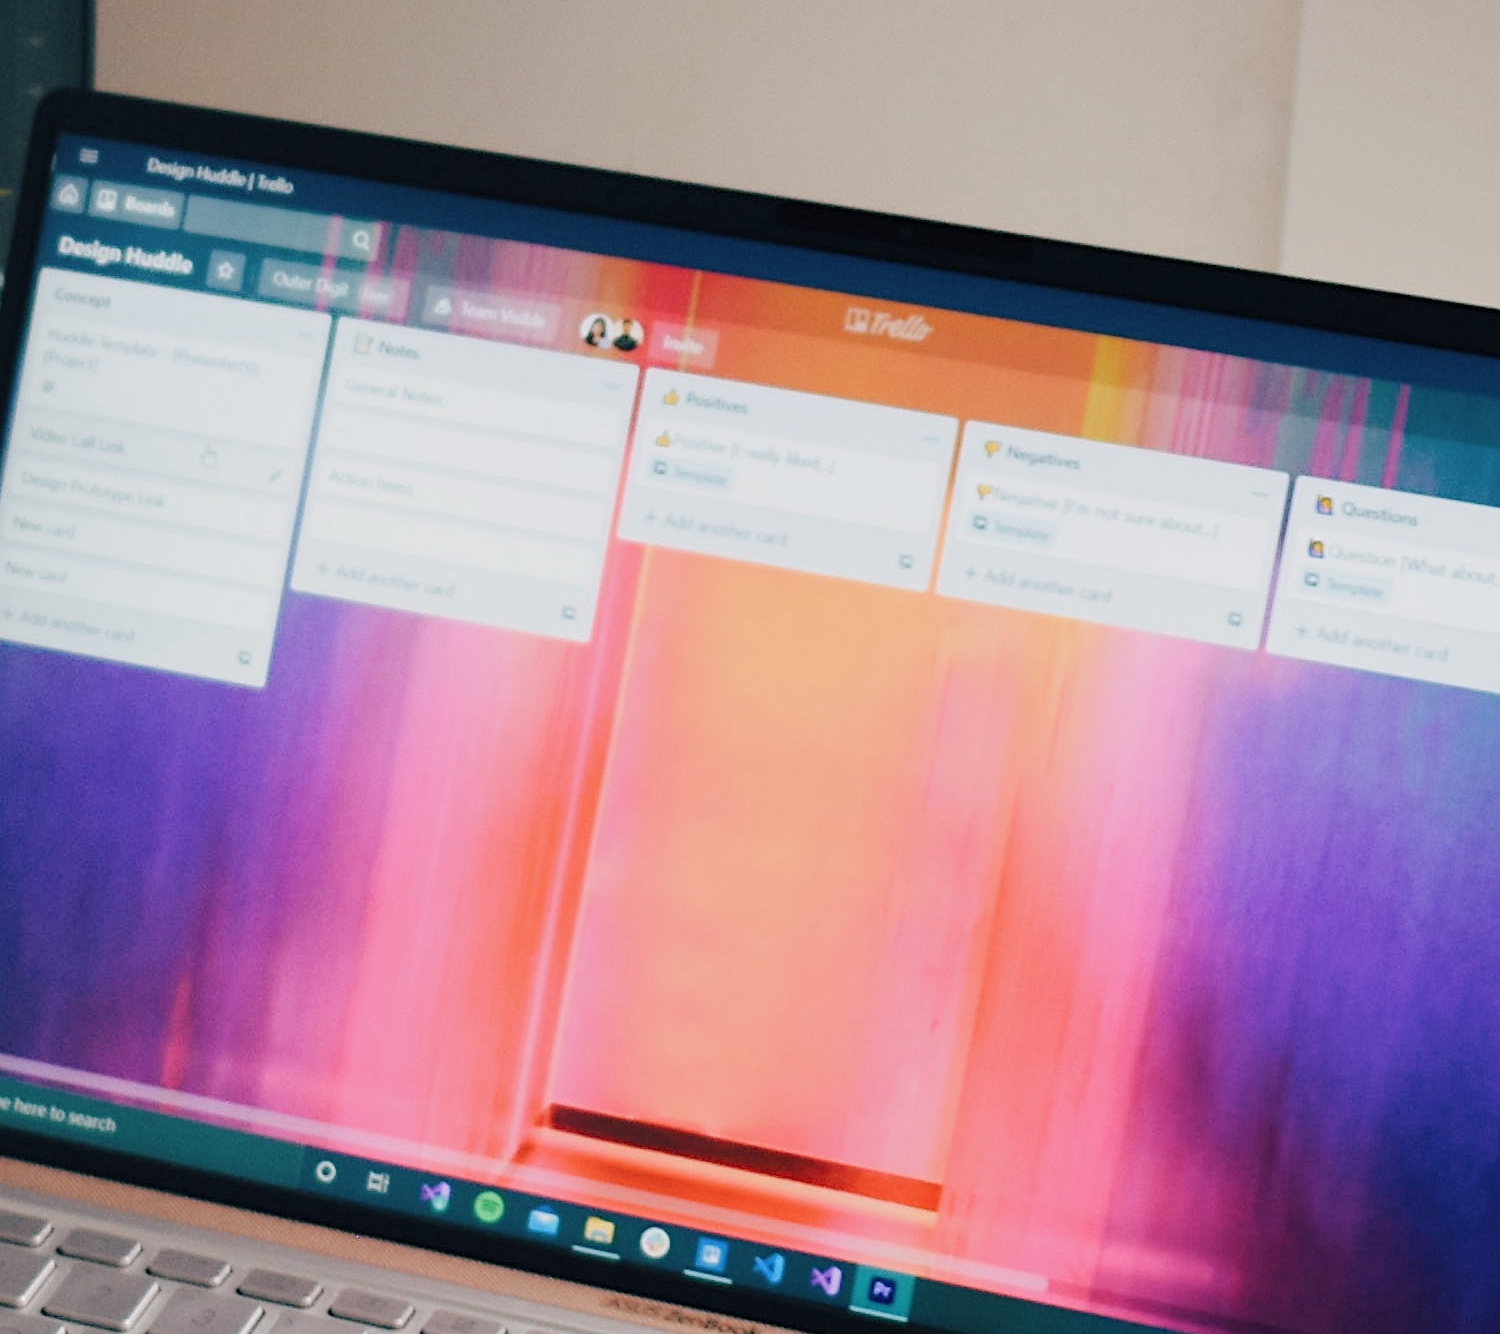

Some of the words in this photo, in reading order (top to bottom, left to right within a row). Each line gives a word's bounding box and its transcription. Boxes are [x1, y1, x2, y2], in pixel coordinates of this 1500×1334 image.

[146, 156, 195, 181] Design
[198, 164, 247, 189] Huddle
[57, 234, 123, 267] Design
[126, 244, 194, 276] Huddle
[54, 285, 112, 310] Concept
[272, 270, 314, 294] Outer
[315, 276, 349, 301] Digit
[869, 310, 935, 343] Trello
[377, 339, 421, 361] Notes
[685, 390, 749, 415] Positives
[1005, 443, 1082, 471] Negatives
[1340, 500, 1421, 528] Questions
[14, 1096, 48, 1117] here
[51, 1104, 66, 1121] to
[69, 1110, 116, 1134] search
